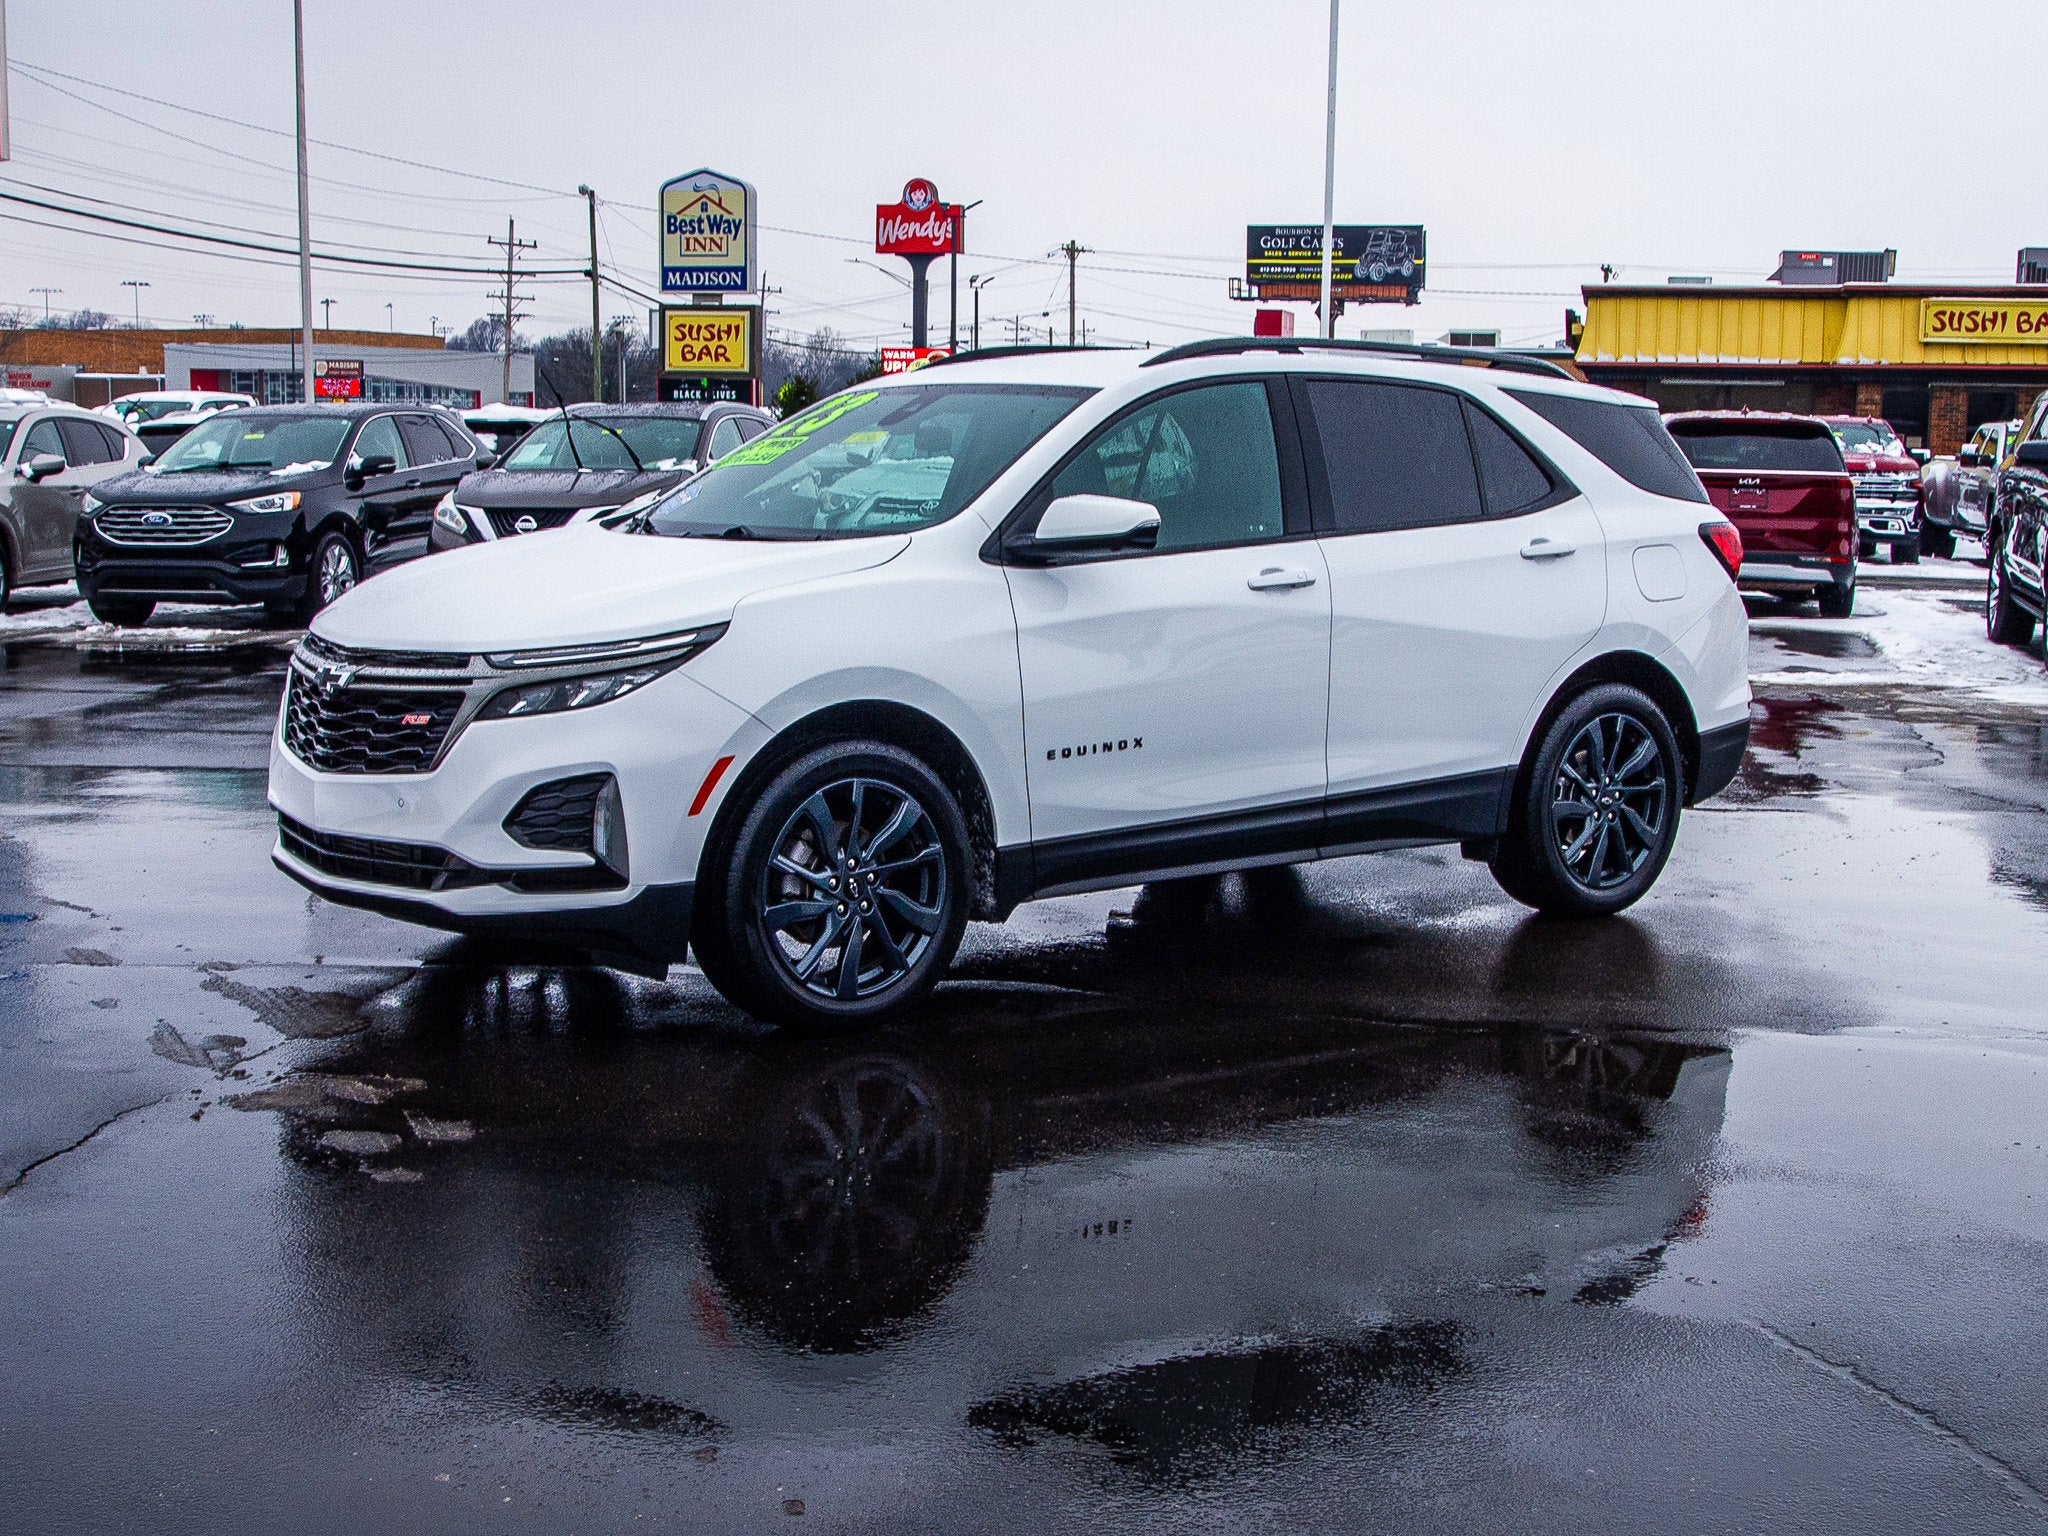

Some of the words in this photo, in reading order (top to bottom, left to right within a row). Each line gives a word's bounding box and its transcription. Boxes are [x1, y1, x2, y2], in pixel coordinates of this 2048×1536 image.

[667, 214, 705, 234] Best
[706, 214, 742, 241] Way
[879, 211, 952, 247] Wendy's
[684, 237, 723, 252] INN
[1260, 236, 1295, 249] GOLF
[667, 271, 741, 286] MADISON
[1932, 310, 2008, 333] SUSHI
[674, 323, 740, 342] SUSHI
[681, 344, 731, 362] BAR
[883, 350, 915, 359] WARM
[328, 361, 359, 369] MADISON
[883, 360, 906, 373] UP!
[673, 390, 702, 399] BLACK
[1738, 477, 1760, 485] KIA
[1046, 736, 1143, 761] EQUINOX
